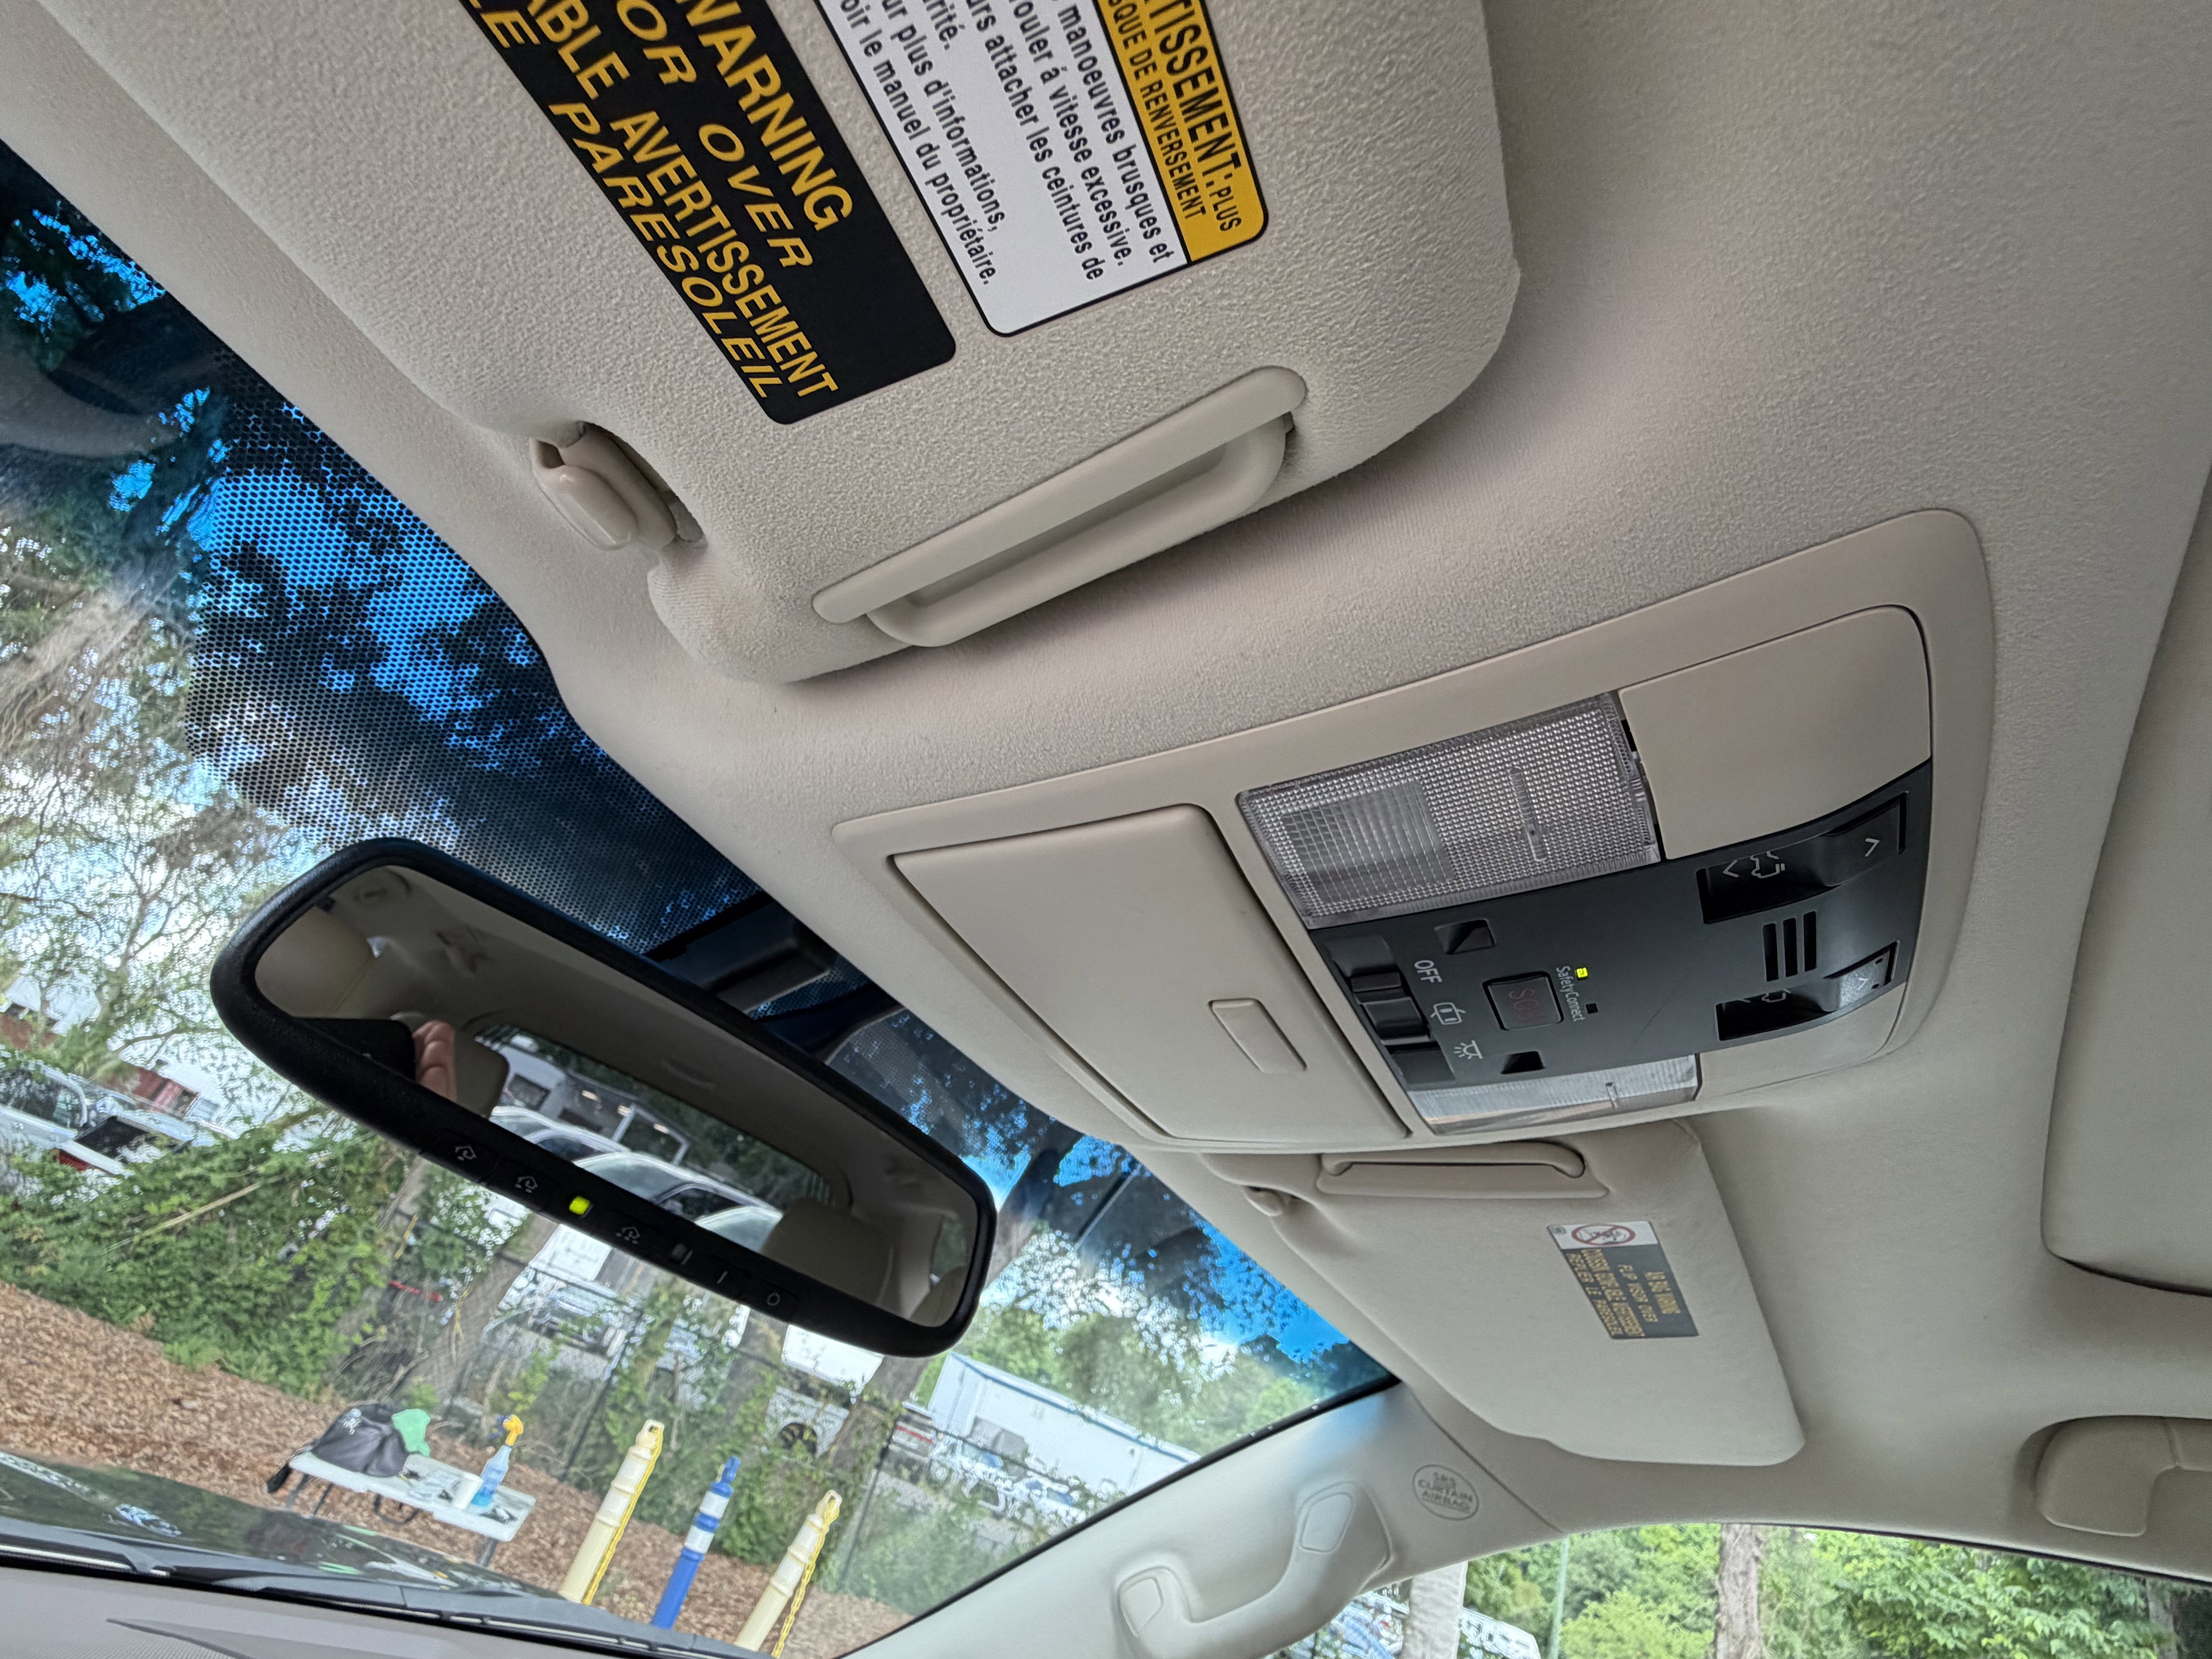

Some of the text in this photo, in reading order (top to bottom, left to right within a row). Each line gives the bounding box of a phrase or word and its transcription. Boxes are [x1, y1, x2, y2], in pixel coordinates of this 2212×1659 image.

[859, 29, 883, 57] le
[873, 59, 931, 140] manuel
[922, 0, 965, 50] rité.
[1129, 47, 1158, 80] DE
[469, 0, 783, 397] E PARESOLEIL
[617, 0, 813, 267] OR OVER
[890, 23, 933, 76] plus
[924, 80, 1005, 232] d'informations,
[915, 143, 941, 170] du
[985, 35, 1039, 126] attacher
[1026, 126, 1053, 163] les
[1042, 166, 1092, 254] ceintures
[1082, 257, 1105, 280] de
[1009, 0, 1053, 63] ouler
[1049, 84, 1093, 163] vitesse
[1081, 166, 1132, 266] excessive.
[1058, 3, 1175, 263] manoeuvres brusques et
[1140, 79, 1206, 219] RENVERSEMENT
[1144, 0, 1242, 232] TISSEMENT: PLUS
[610, 110, 838, 397] AVERTISSEMENT
[925, 172, 996, 285] propriétaire.
[1414, 960, 1443, 983] OFF
